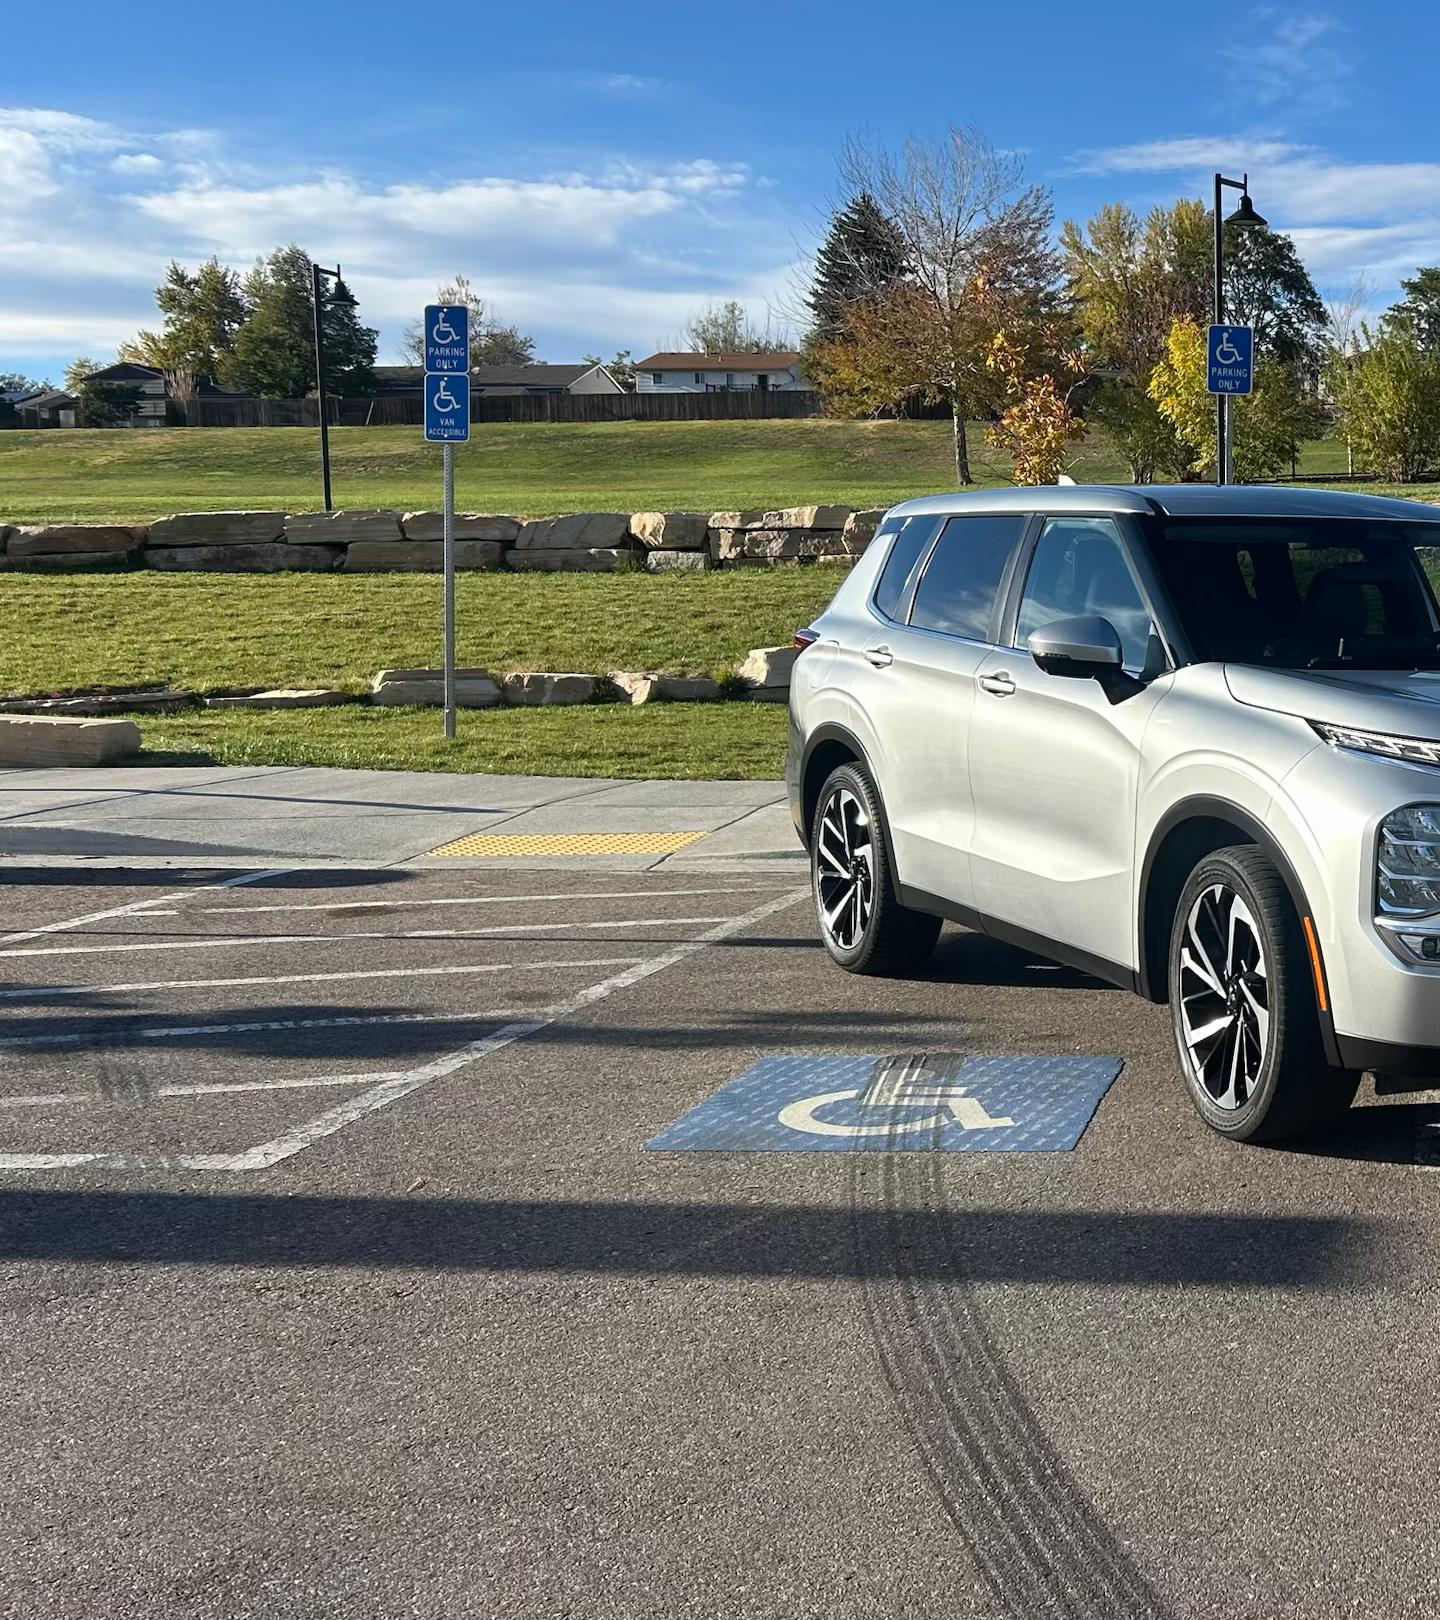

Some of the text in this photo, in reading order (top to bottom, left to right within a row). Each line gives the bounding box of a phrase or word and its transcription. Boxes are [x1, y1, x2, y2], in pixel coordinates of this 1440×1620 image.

[429, 347, 465, 357] PARKING
[436, 359, 458, 369] ONLY
[1211, 367, 1248, 378] PARKING
[1218, 380, 1240, 390] ONLY
[440, 417, 455, 426] VAN
[428, 428, 466, 436] ACCESSIBLE
